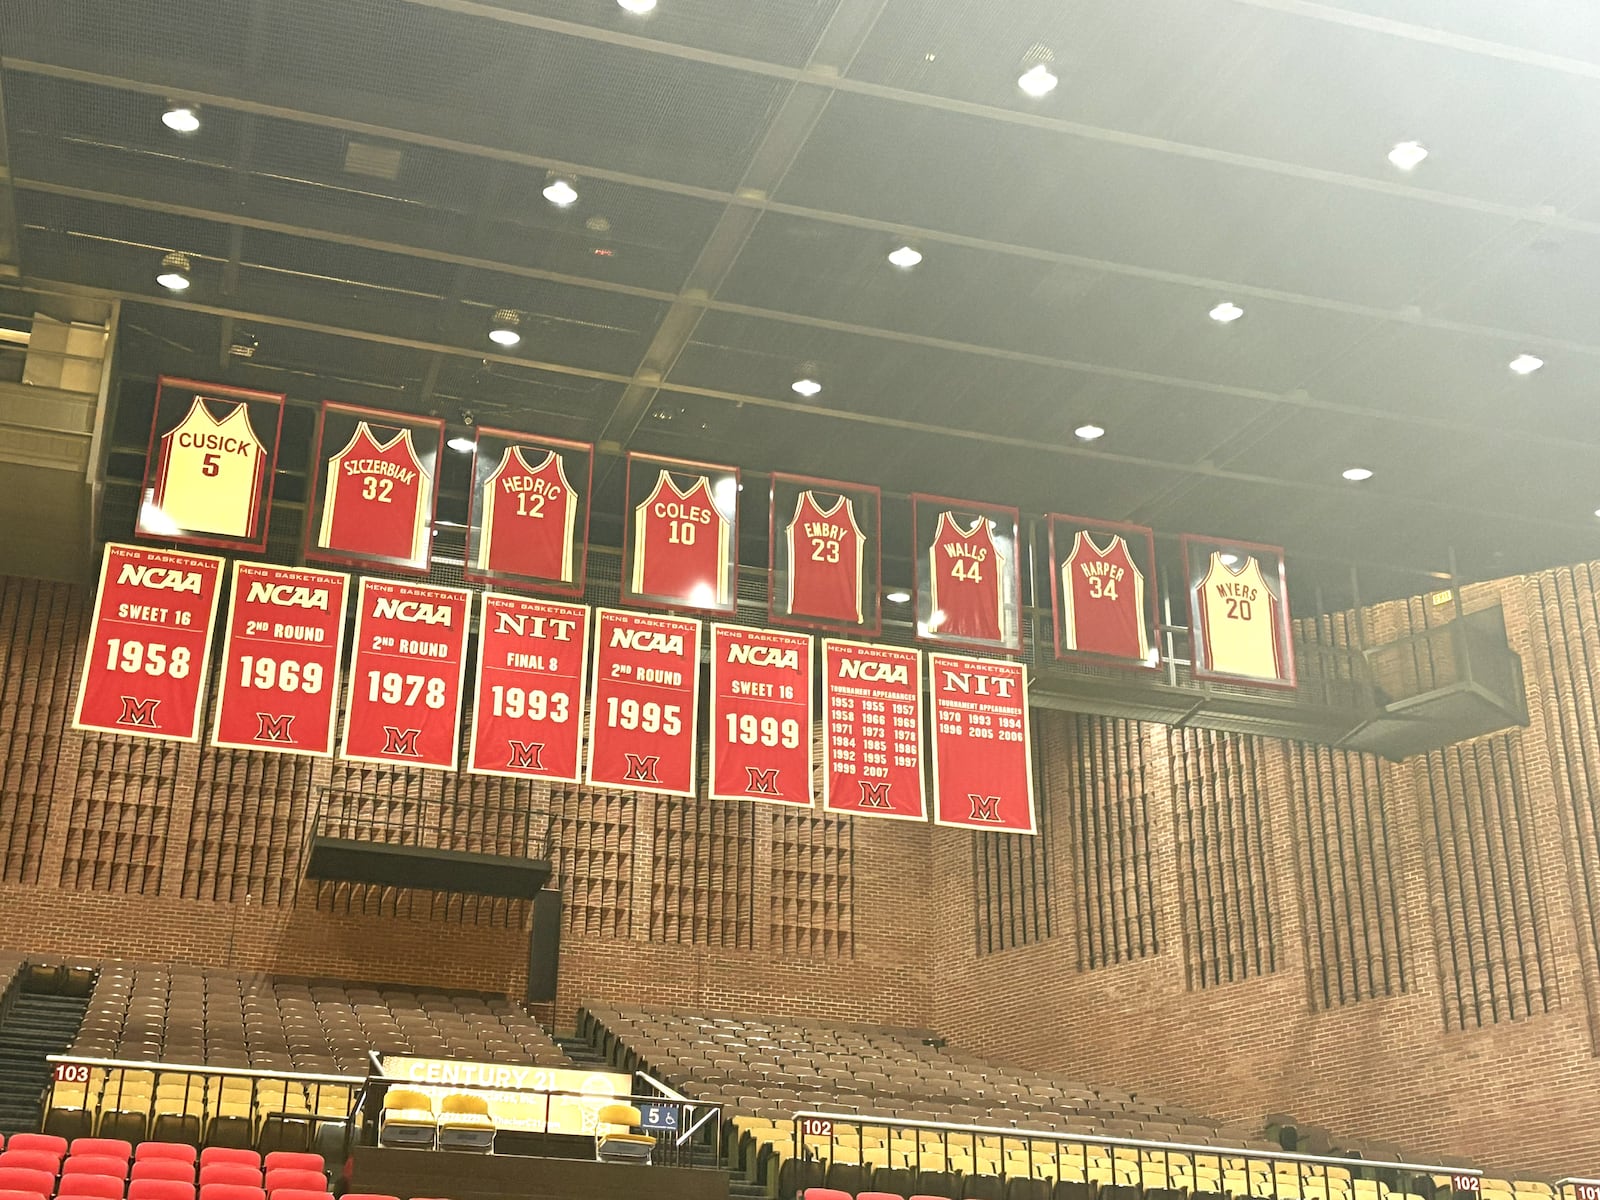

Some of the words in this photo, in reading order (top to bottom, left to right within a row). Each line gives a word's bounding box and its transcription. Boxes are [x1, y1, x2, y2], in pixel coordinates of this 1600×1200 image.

[179, 432, 250, 456] CUSICK
[202, 454, 220, 477] 5
[344, 459, 416, 485] SZCZERBIAK
[362, 476, 393, 503] 32
[502, 476, 560, 500] HEDRIC
[517, 492, 545, 518] 12
[655, 502, 711, 524] COLES
[669, 521, 695, 545] 10
[804, 522, 848, 541] EMBRY
[111, 550, 140, 558] MENS
[147, 554, 217, 569] BASKETBALL
[812, 539, 840, 563] 23
[944, 543, 987, 562] WALLS
[117, 563, 202, 594] NCAA
[240, 568, 268, 577] MENS
[275, 572, 342, 585] BASKETBALL
[951, 559, 982, 583] 44
[1080, 561, 1124, 582] HARPER
[246, 581, 329, 611] NCAA
[366, 584, 393, 593] MENS
[400, 588, 465, 602] BASKETBALL
[1088, 576, 1118, 600] 34
[1216, 583, 1258, 601] MYERS
[118, 603, 168, 622] SWEET
[175, 610, 191, 625] 16
[372, 598, 452, 627] NCAA
[488, 600, 514, 609] MENS
[521, 604, 584, 617] BASKETBALL
[1226, 599, 1251, 621] 20
[246, 621, 269, 635] 2ND
[274, 623, 324, 642] ROUND
[494, 612, 576, 642] NIT
[602, 614, 628, 623] MENS
[634, 619, 695, 631] BASKETBALL
[372, 636, 394, 650] 2ND
[400, 638, 448, 658] ROUND
[610, 628, 683, 656] NCAA
[717, 630, 742, 638] MENS
[748, 634, 808, 646] BASKETBALL
[106, 638, 191, 679] 1958
[507, 652, 544, 670] FINAL
[549, 658, 558, 671] 8
[727, 644, 798, 670] NCAA
[858, 649, 916, 660] BASKETBALL
[240, 655, 323, 694] 1969
[611, 664, 631, 677] 2ND
[637, 666, 682, 686] ROUND
[839, 658, 908, 684] NCAA
[935, 659, 958, 667] MENS
[965, 664, 1021, 674] BASKETBALL
[368, 670, 446, 709] 1978
[732, 680, 773, 698] SWEET
[780, 686, 793, 699] 16
[831, 685, 870, 696] TOURNAMENT
[873, 690, 916, 700] APPEARANCES
[942, 671, 1015, 697] NIT
[491, 685, 570, 724] 1993
[832, 697, 854, 708] 1953
[862, 700, 884, 712] 1955
[893, 704, 914, 715] 1957
[939, 699, 978, 710] TOURNAMENT
[607, 697, 682, 736] 1995
[832, 710, 854, 721] 1958
[862, 713, 885, 725] 1966
[893, 717, 915, 728] 1969
[939, 711, 961, 722] 1970
[969, 714, 991, 726] 1993
[999, 718, 1021, 729] 1994
[726, 713, 799, 749] 1999
[832, 723, 852, 734] 1971
[862, 726, 884, 738] 1973
[894, 730, 915, 741] 1978
[940, 724, 962, 735] 1996
[969, 727, 993, 739] 2005
[999, 731, 1022, 742] 2006
[832, 736, 855, 748] 1984
[863, 740, 886, 751] 1985
[894, 743, 916, 754] 1986
[833, 749, 855, 761] 1992
[863, 753, 886, 764] 1995
[894, 756, 916, 767] 1997
[833, 762, 856, 774] 1999
[864, 766, 888, 778] 2007
[56, 1065, 88, 1082] 103
[410, 1062, 528, 1088] CENTURY
[534, 1070, 556, 1091] 21
[649, 1108, 660, 1124] 5
[804, 1120, 831, 1136] 102
[1454, 1176, 1478, 1191] 102
